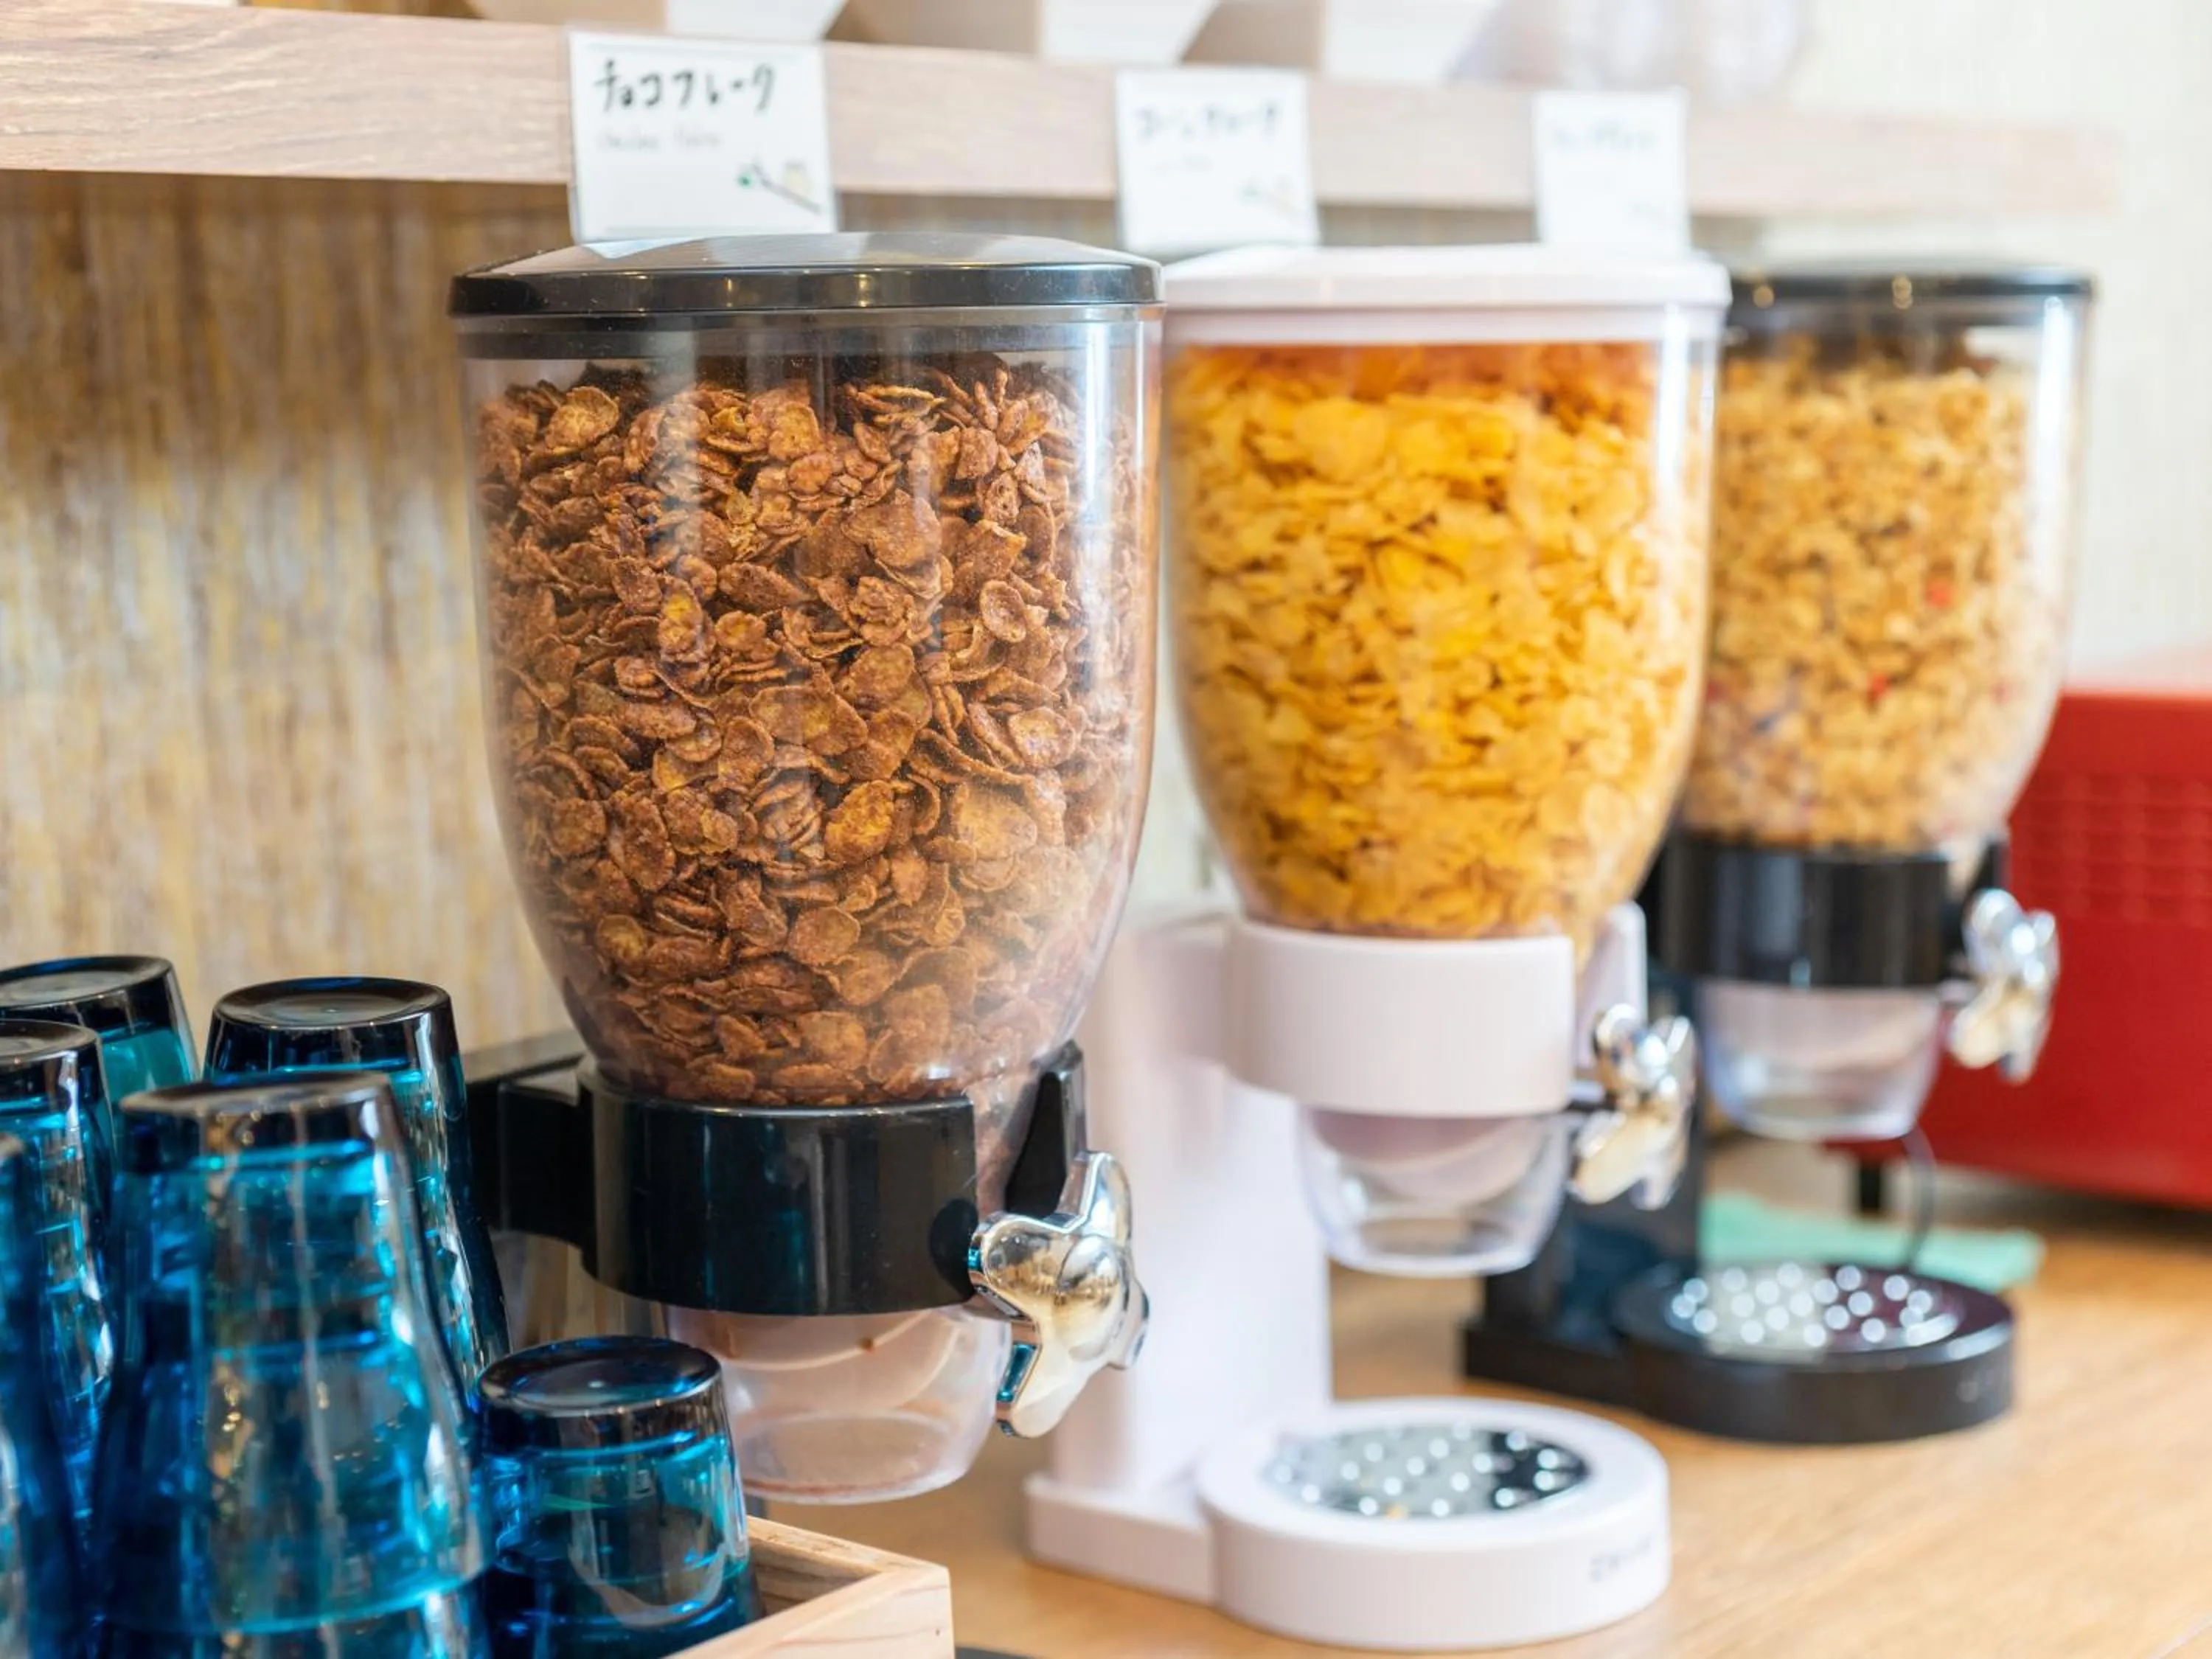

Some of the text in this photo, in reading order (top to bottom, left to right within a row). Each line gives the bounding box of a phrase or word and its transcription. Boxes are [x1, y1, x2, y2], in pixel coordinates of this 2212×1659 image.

[593, 58, 775, 113] チョコフレーク
